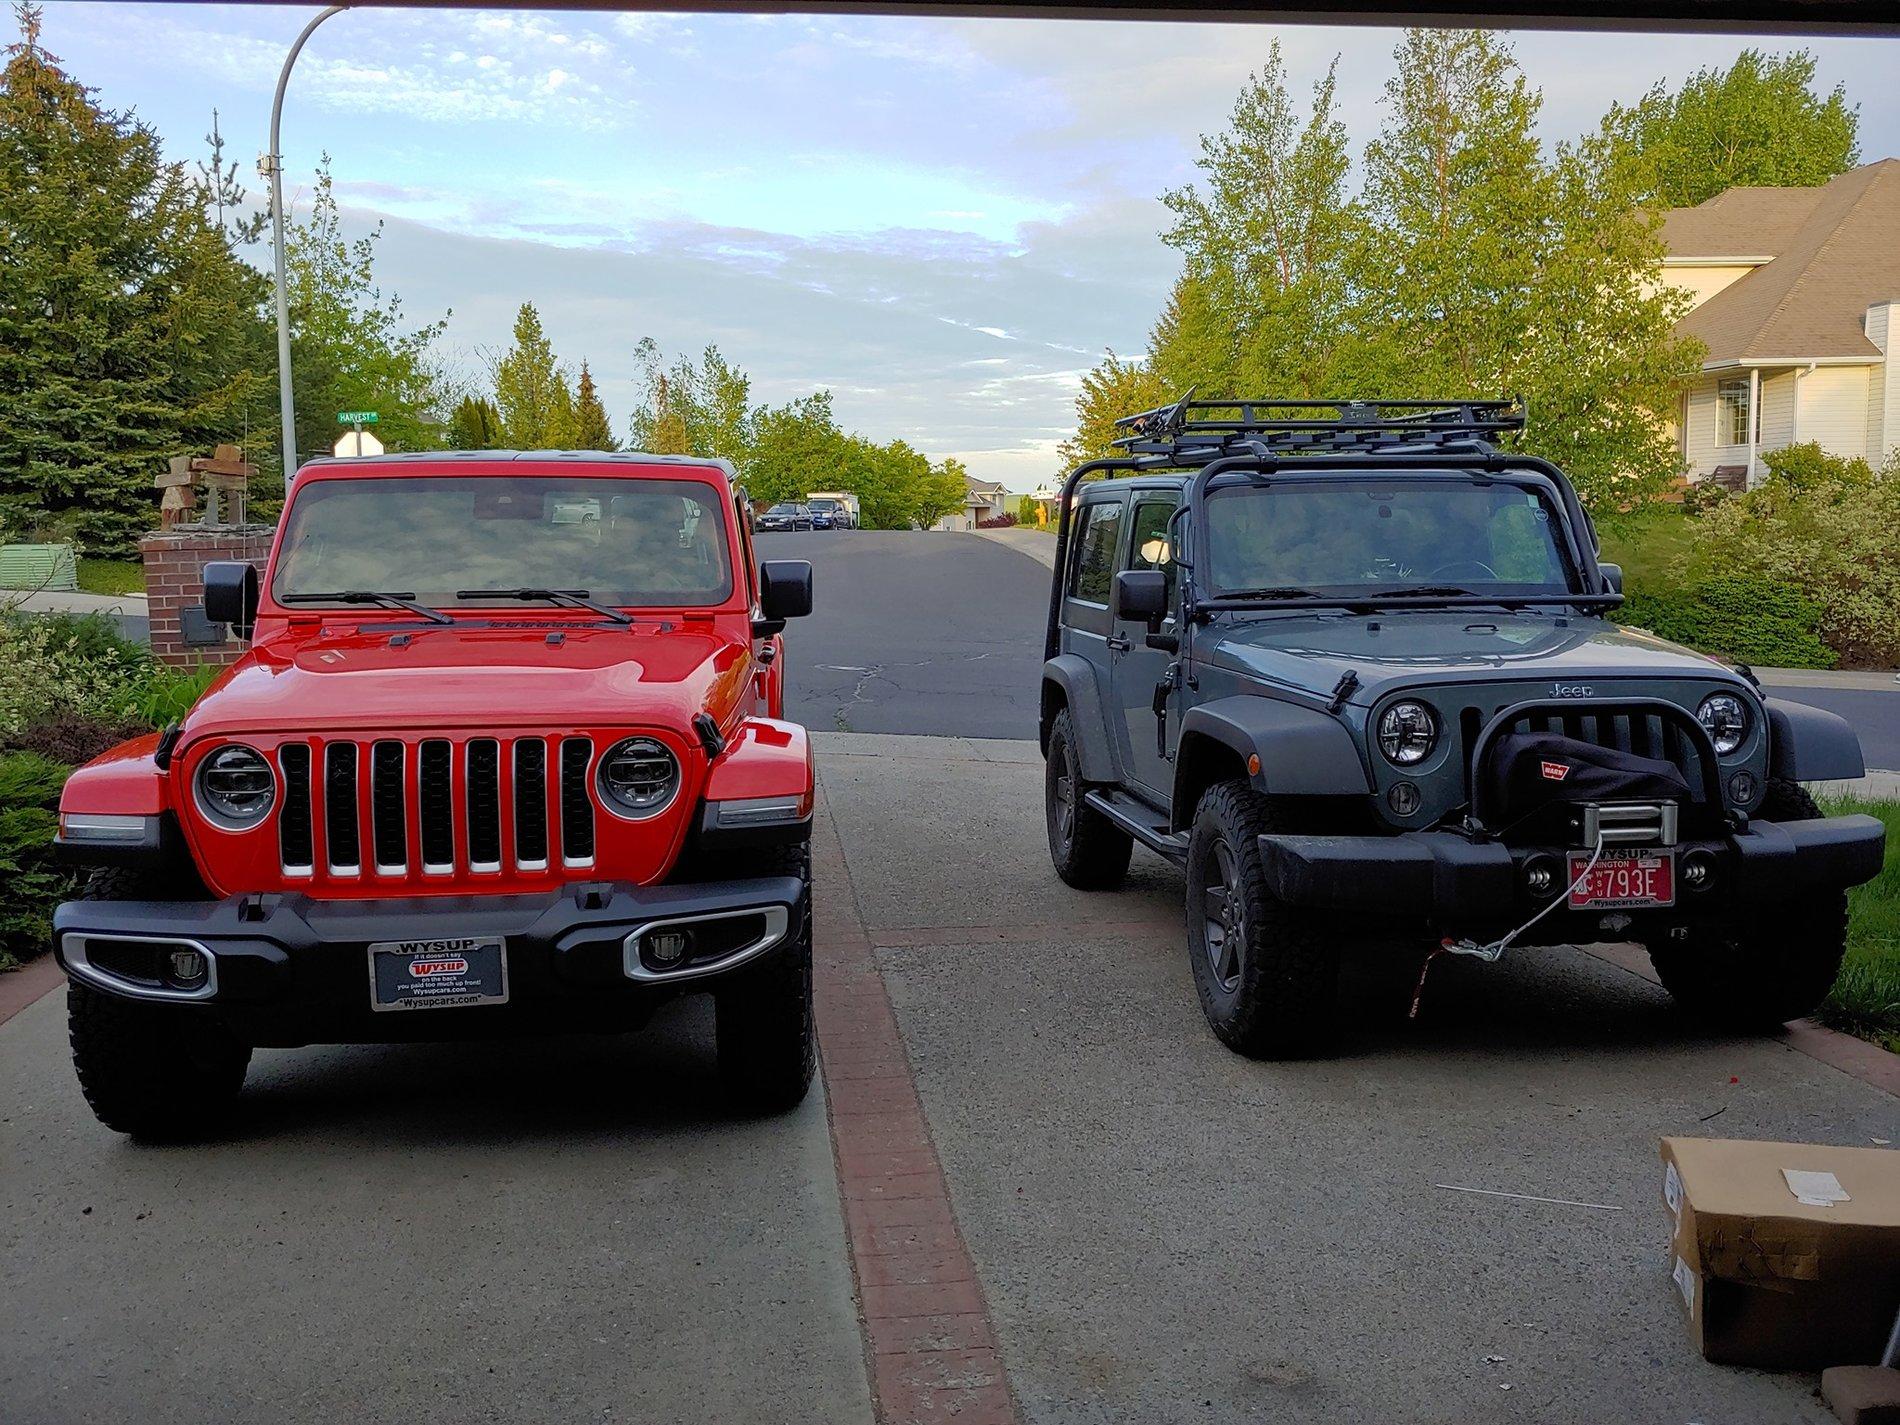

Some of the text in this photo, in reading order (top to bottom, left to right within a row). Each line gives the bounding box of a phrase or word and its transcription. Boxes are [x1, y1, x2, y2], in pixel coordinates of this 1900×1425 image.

[340, 413, 370, 421] HARVEST
[1549, 683, 1593, 699] Jeep
[1575, 860, 1630, 869] WAHINGTON
[1604, 868, 1657, 898] 793E
[413, 987, 467, 996] Wysupcars.com
